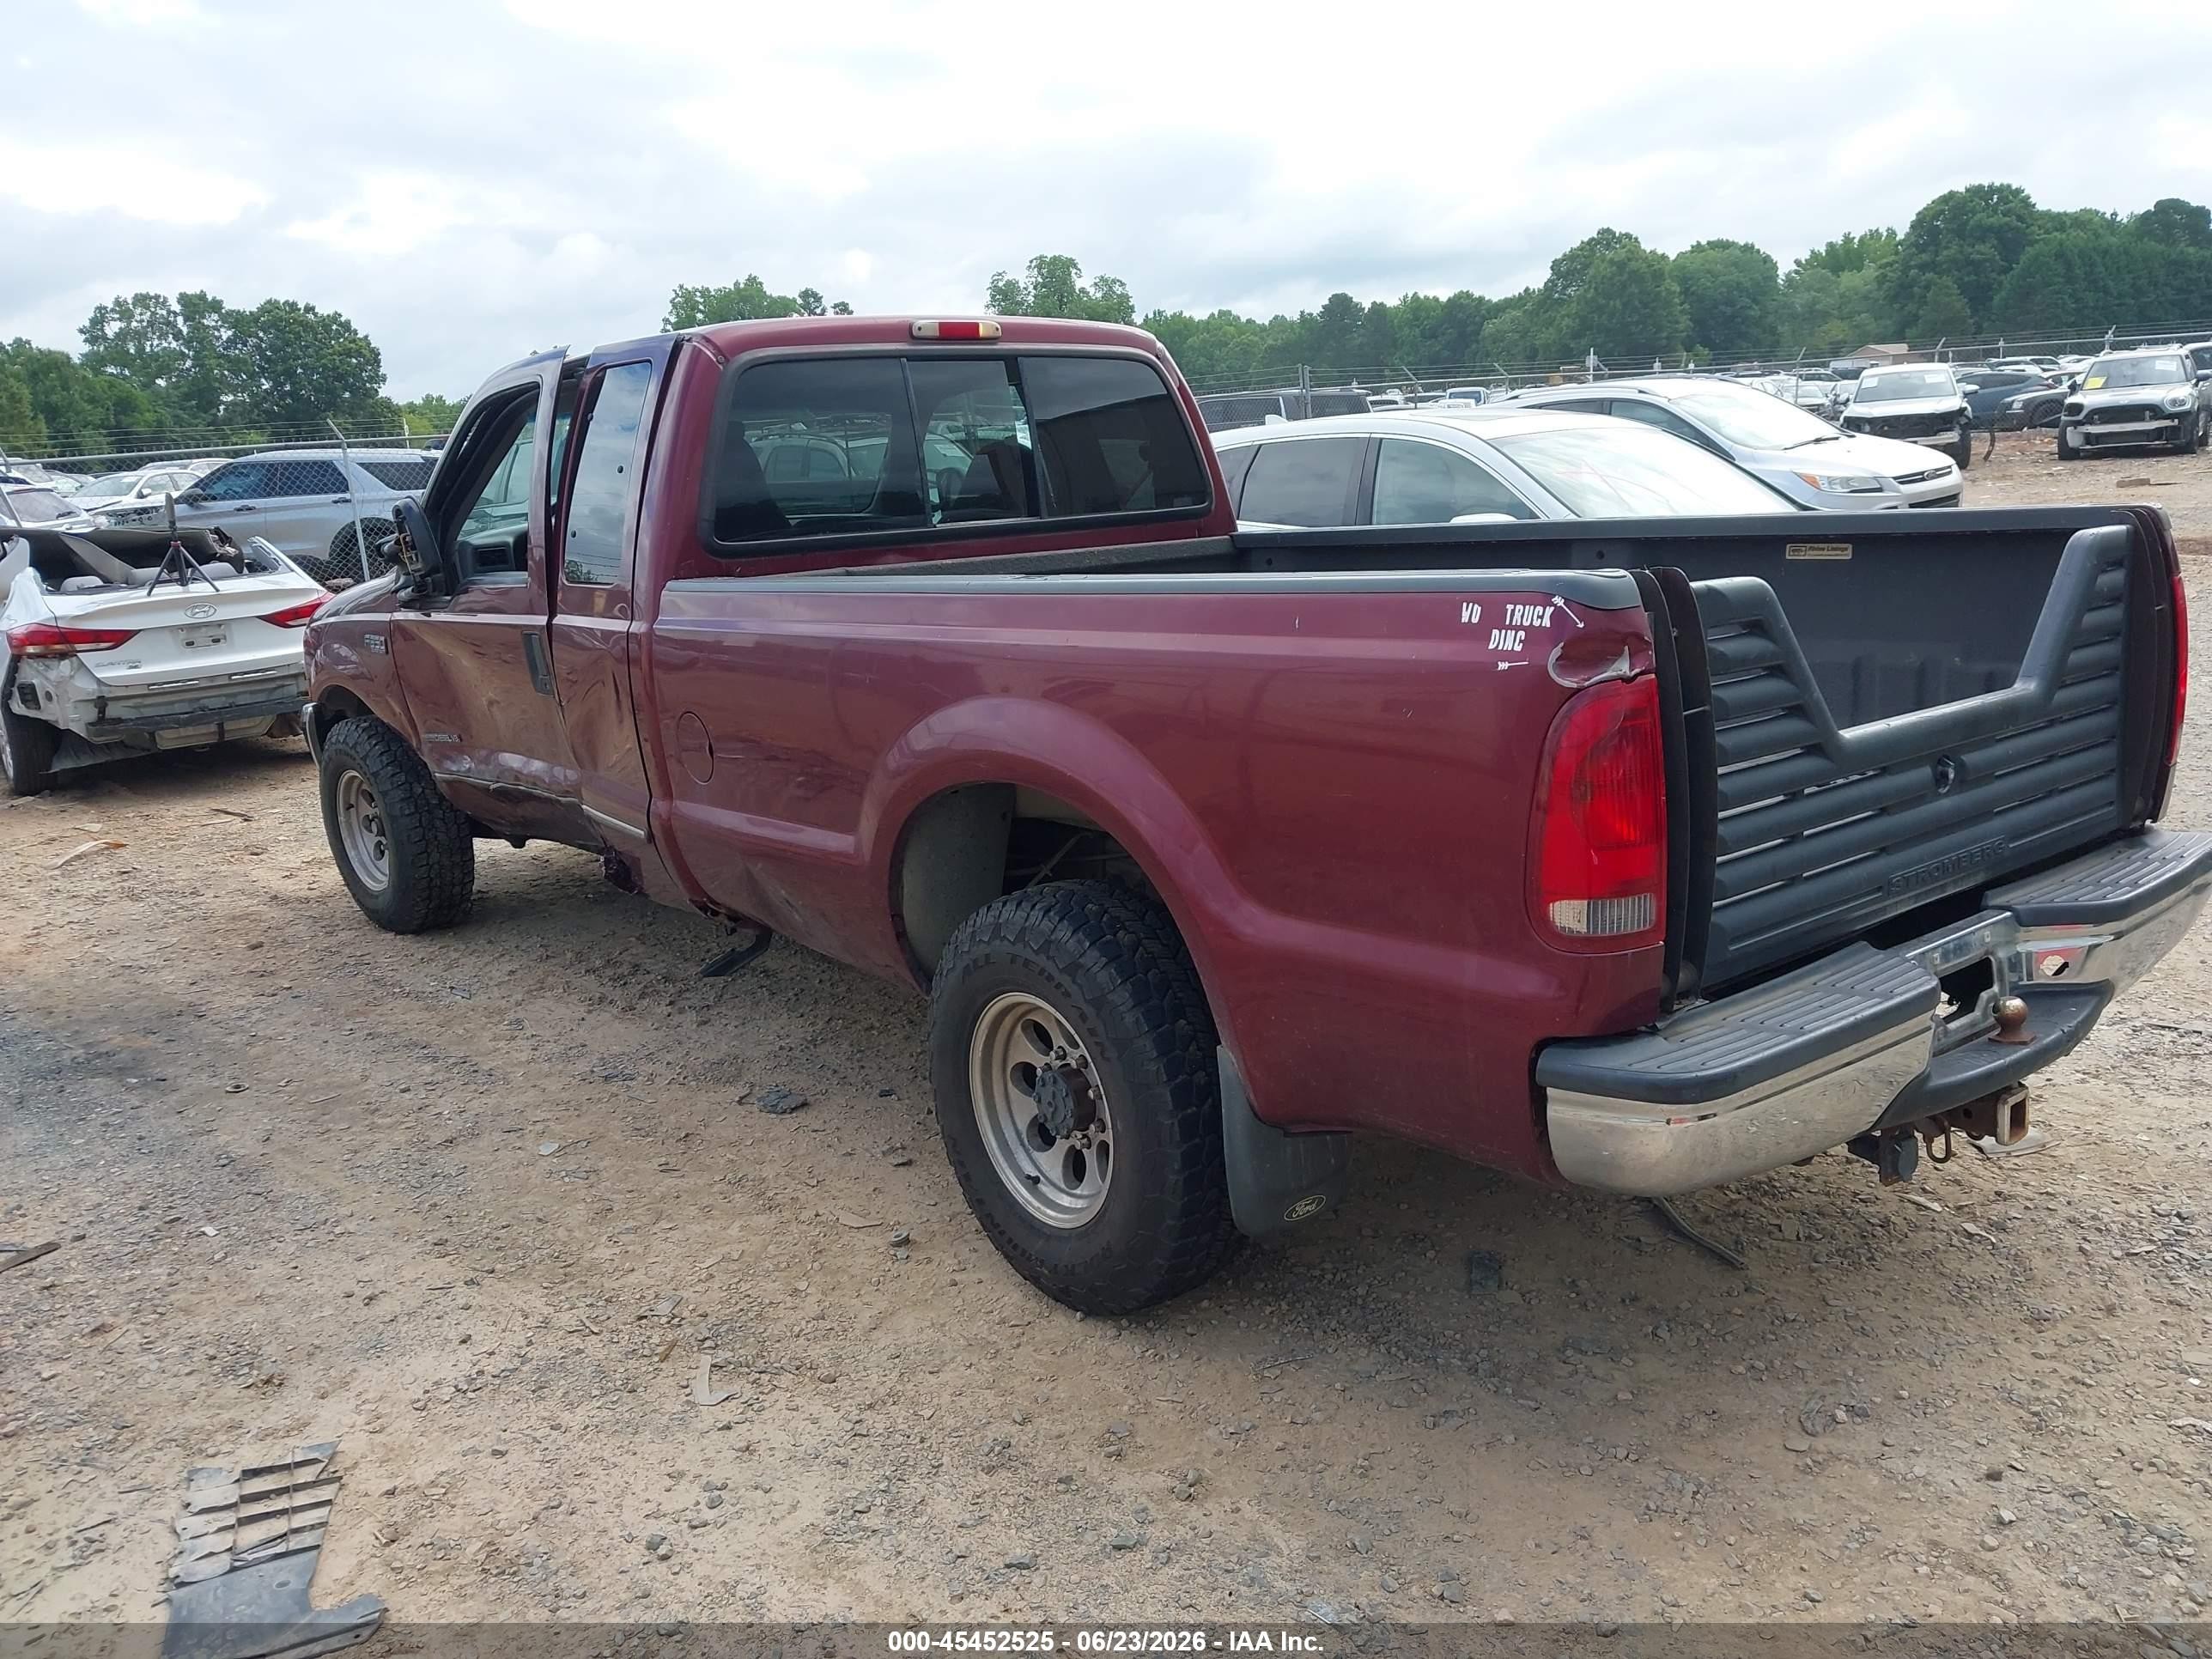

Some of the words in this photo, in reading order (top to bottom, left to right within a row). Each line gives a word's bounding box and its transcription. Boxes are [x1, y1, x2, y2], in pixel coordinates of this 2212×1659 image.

[1505, 604, 1555, 628] TRUCK
[1889, 839, 2008, 892] STROMBERG
[1290, 1197, 1322, 1219] Ford
